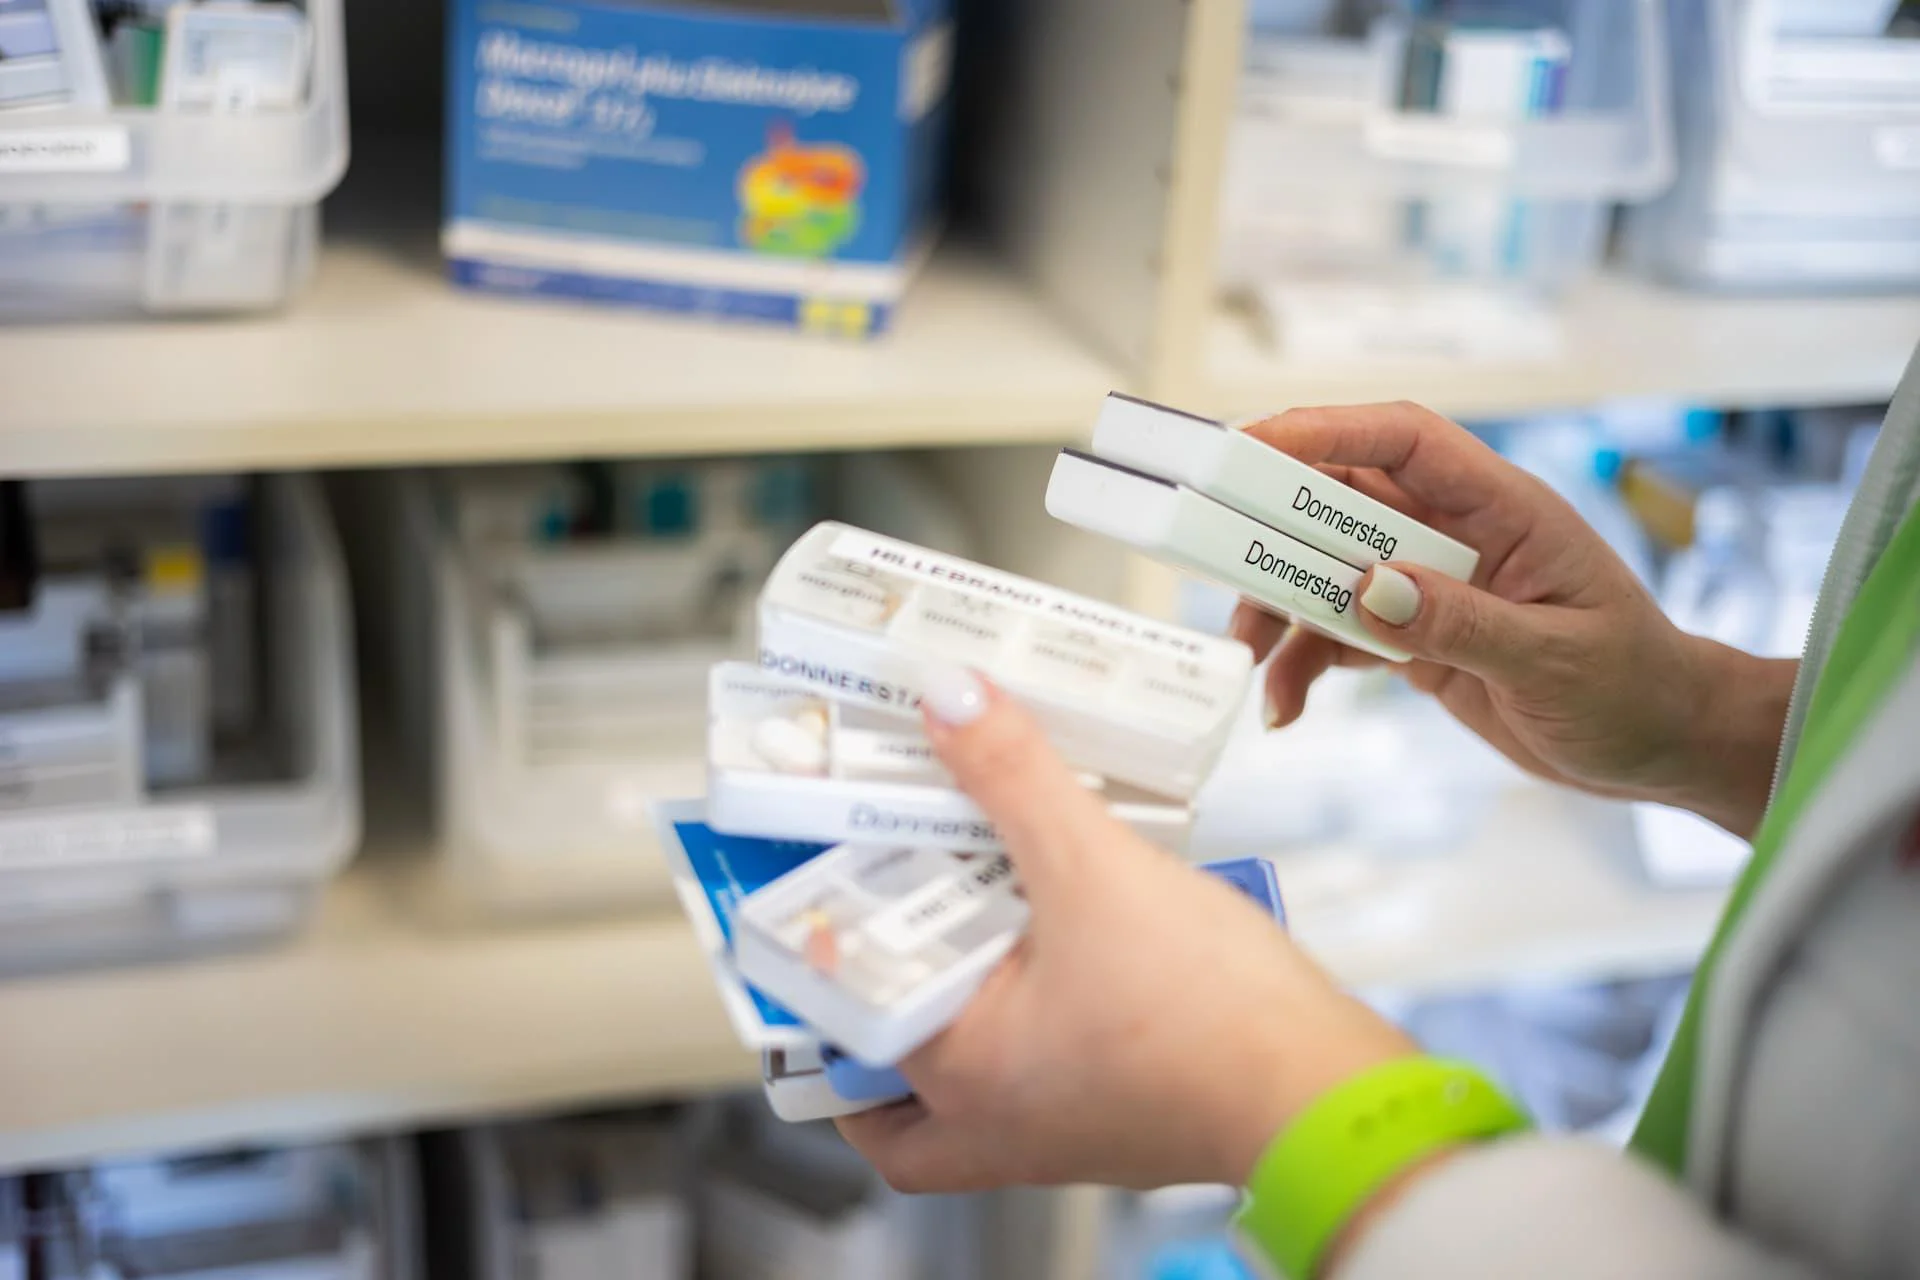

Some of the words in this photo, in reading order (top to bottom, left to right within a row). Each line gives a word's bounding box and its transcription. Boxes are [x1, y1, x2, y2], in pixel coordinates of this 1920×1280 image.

[1292, 486, 1398, 560] Donnerstag
[870, 546, 1042, 606] HILLEBRAND
[1244, 540, 1353, 613] Donnerstag
[758, 649, 924, 710] DONNERSTA
